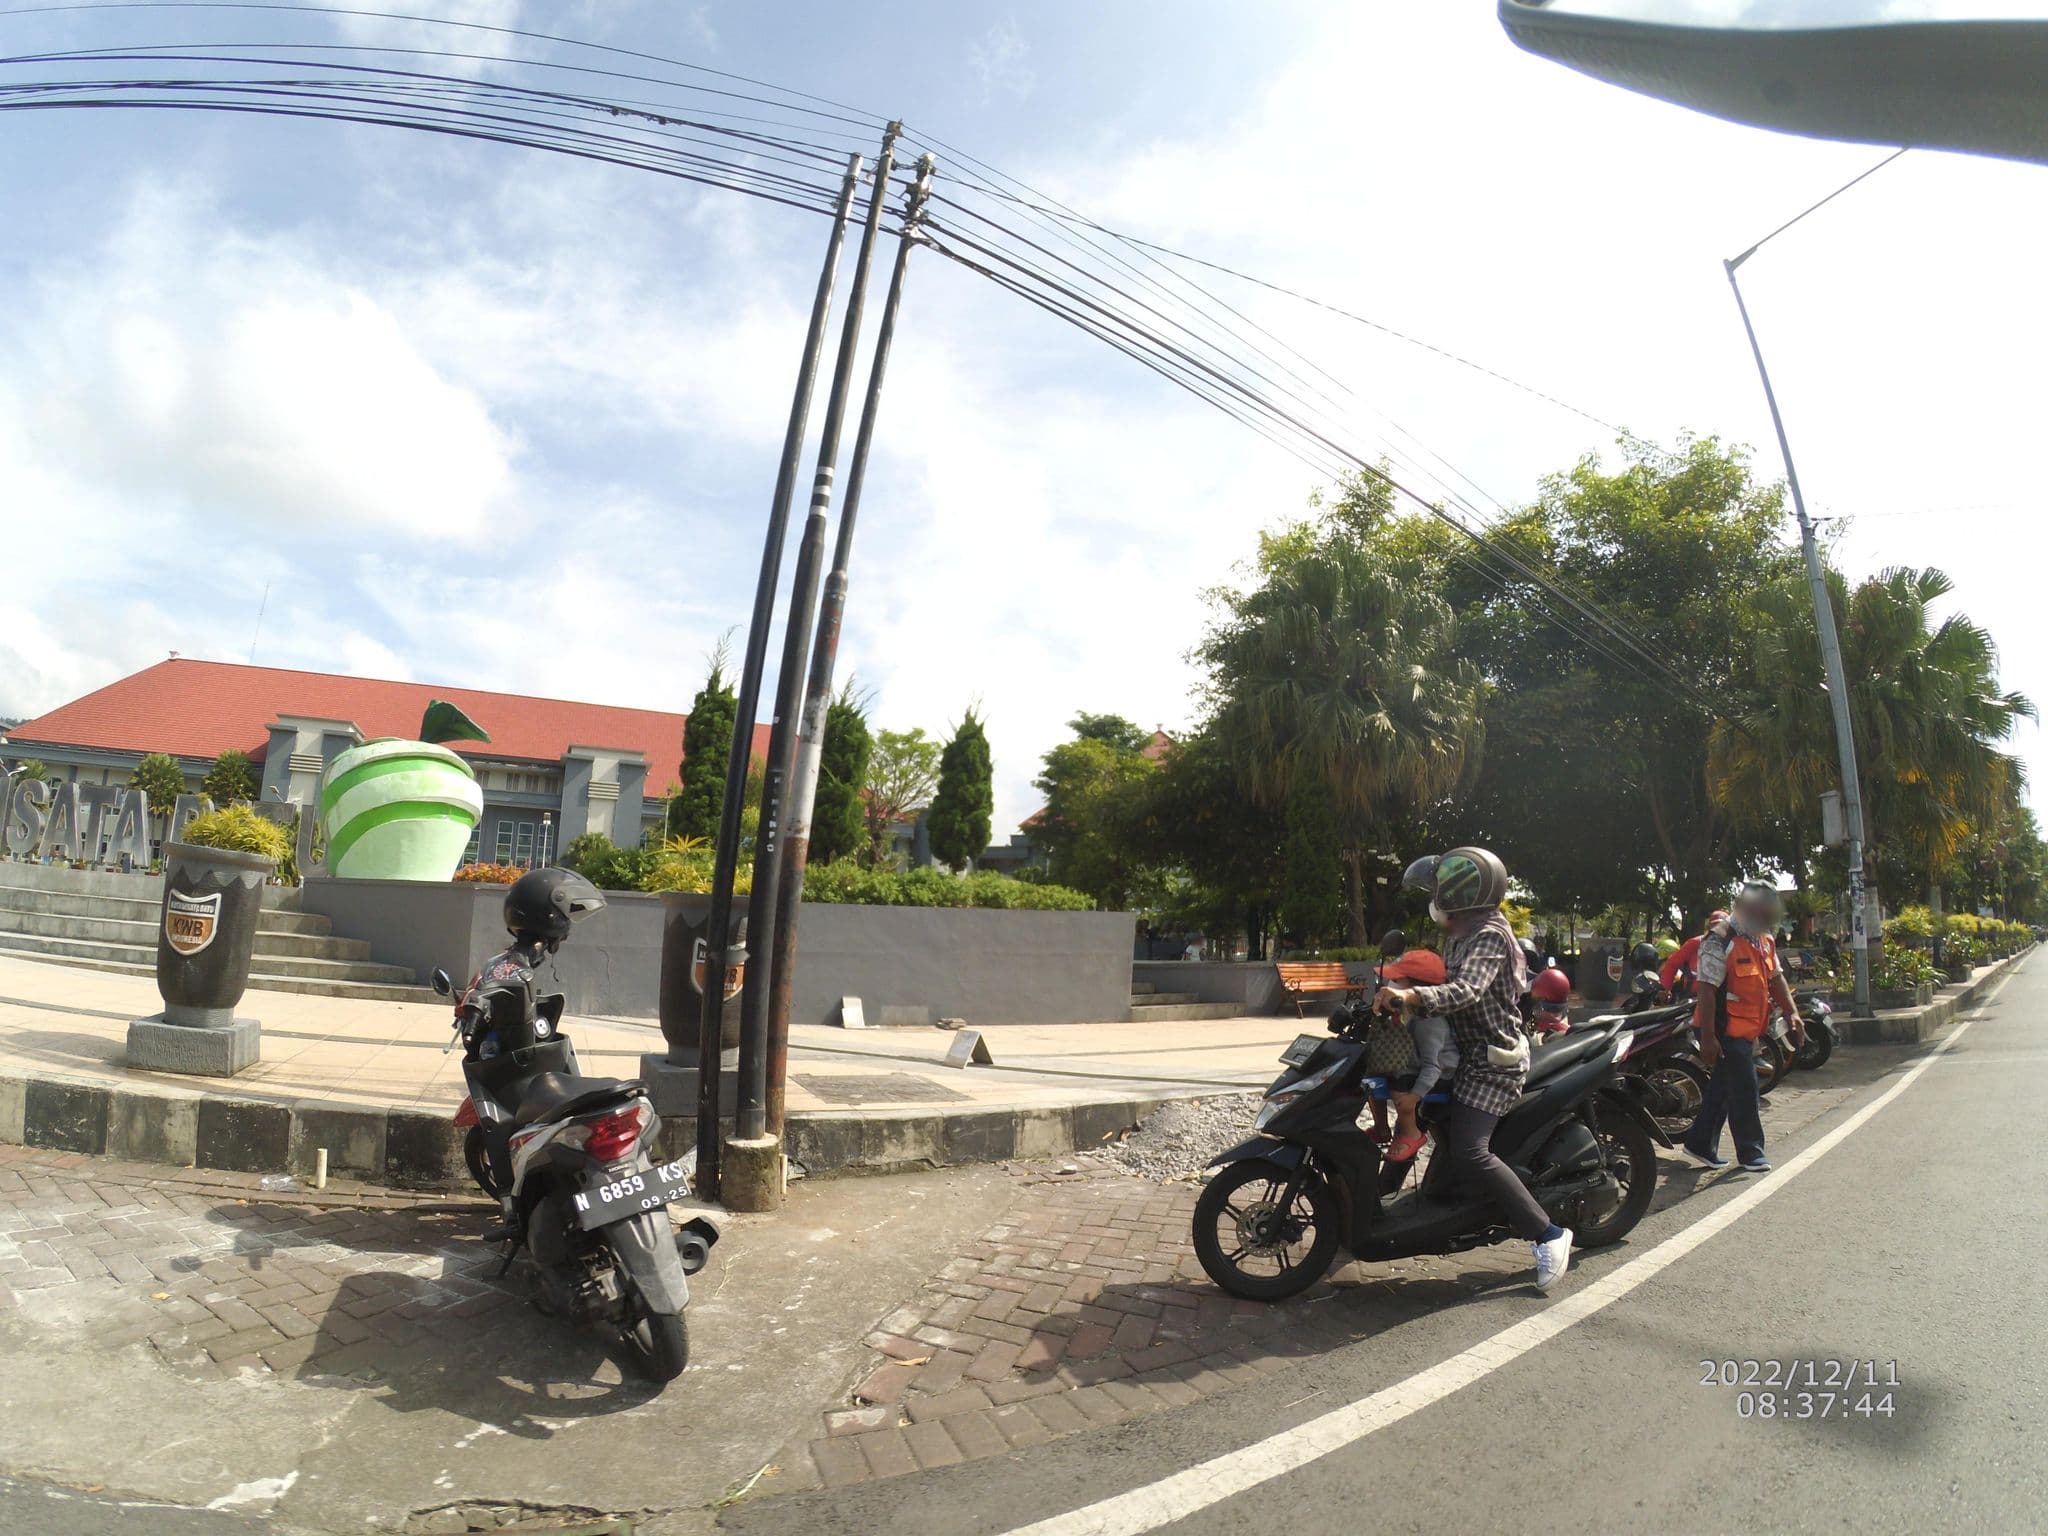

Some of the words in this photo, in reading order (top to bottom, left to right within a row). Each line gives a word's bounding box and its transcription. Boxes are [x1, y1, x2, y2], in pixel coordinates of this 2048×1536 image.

[174, 917, 204, 937] KWB
[575, 1193, 590, 1211] N
[599, 1175, 645, 1203] 6859
[657, 1162, 682, 1183] KS
